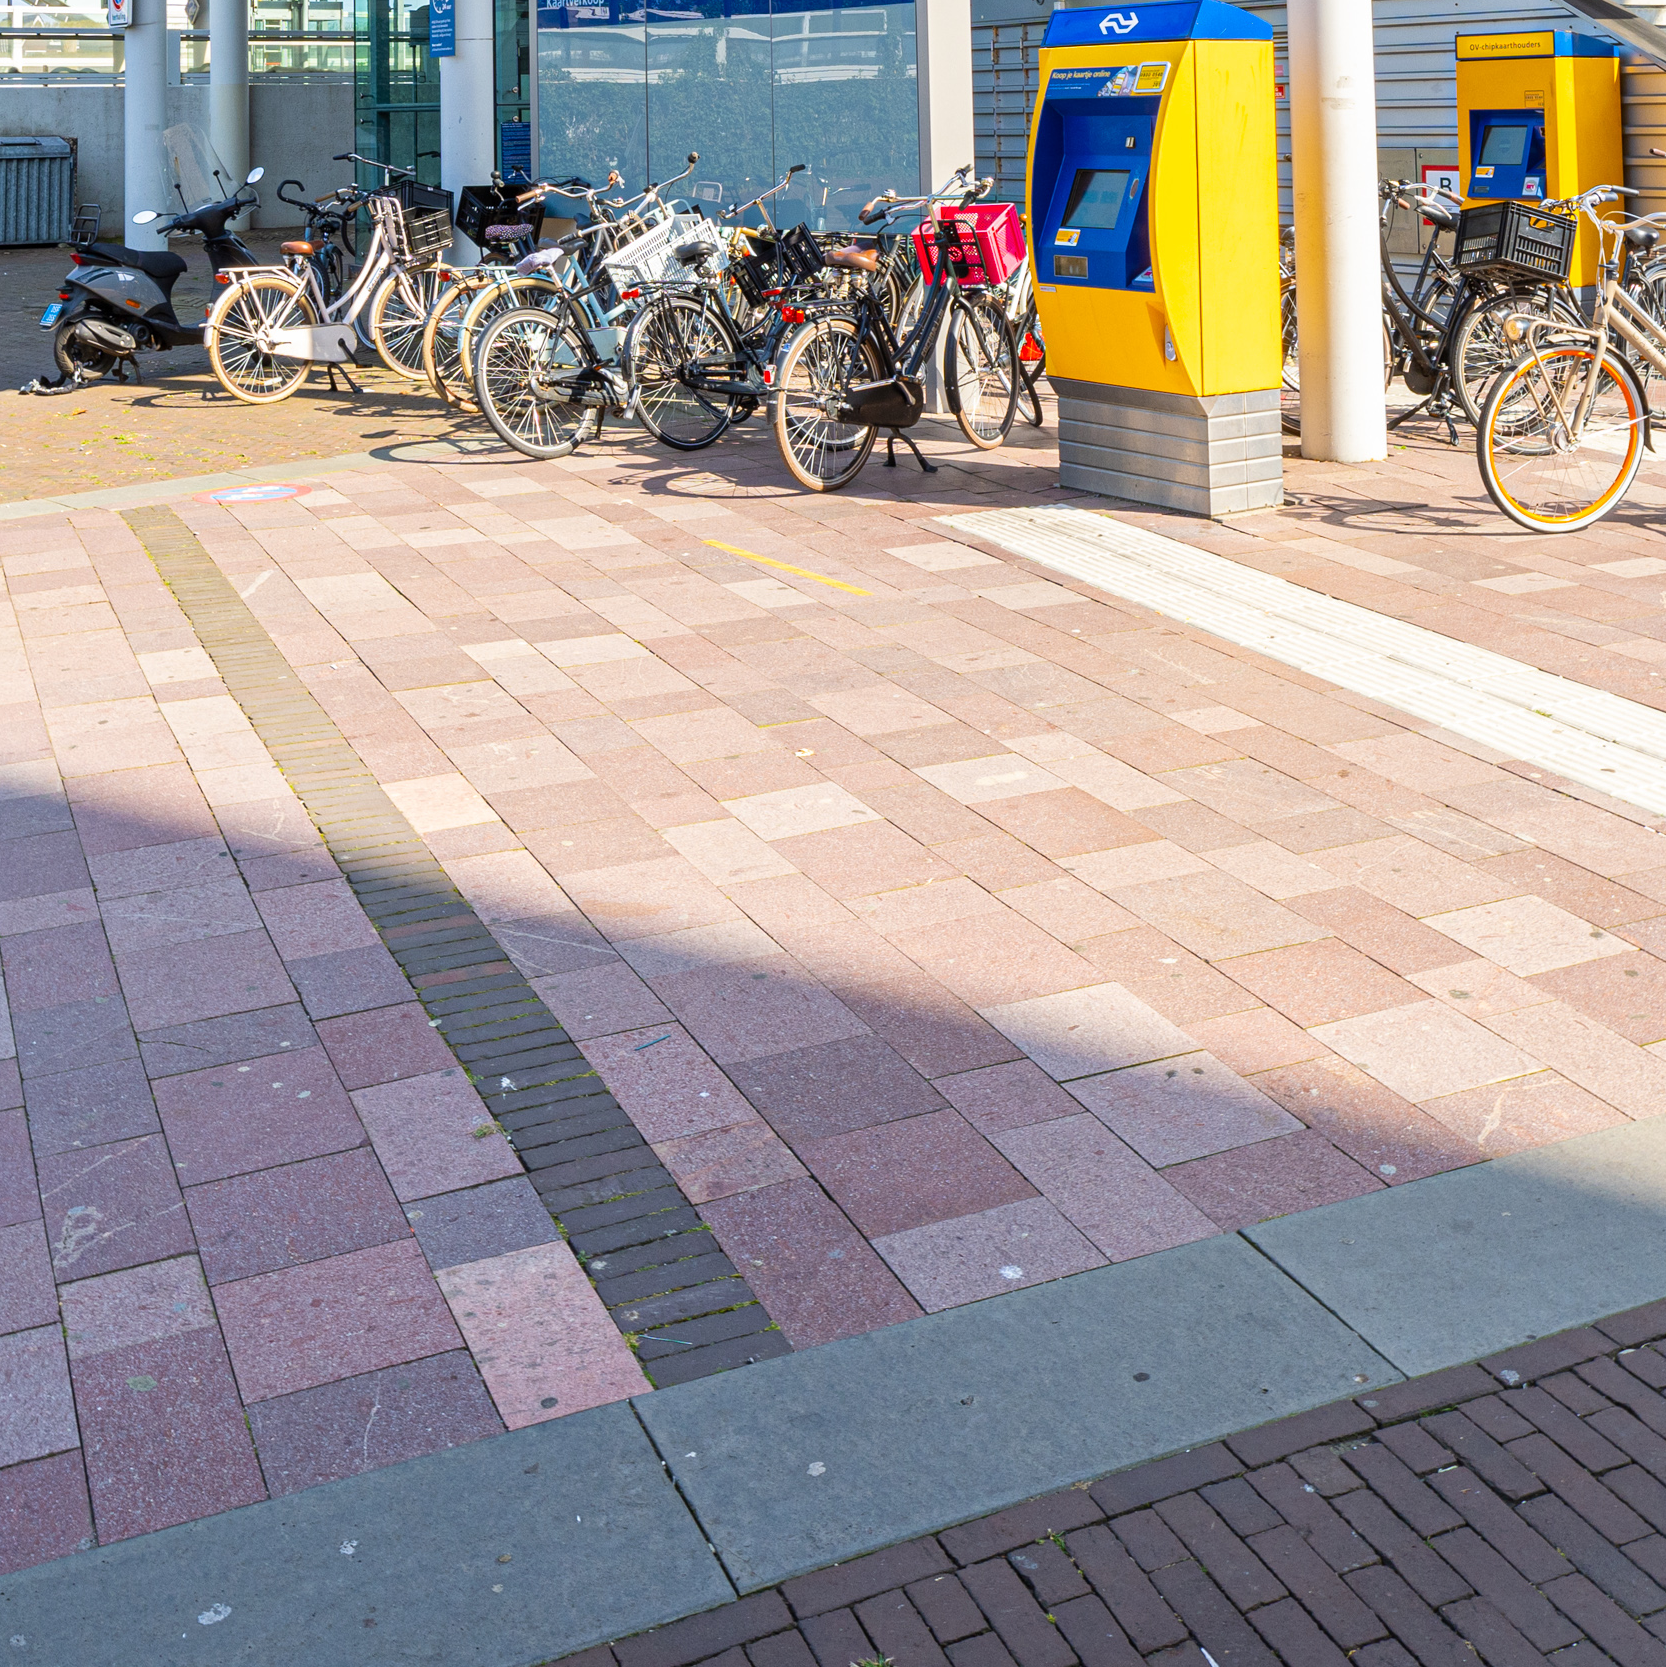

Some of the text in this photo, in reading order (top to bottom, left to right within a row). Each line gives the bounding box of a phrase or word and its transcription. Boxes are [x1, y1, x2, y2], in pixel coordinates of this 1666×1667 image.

[1469, 41, 1541, 52] OV-chipkaarthouders
[1052, 69, 1111, 80] Koop je kaartje online
